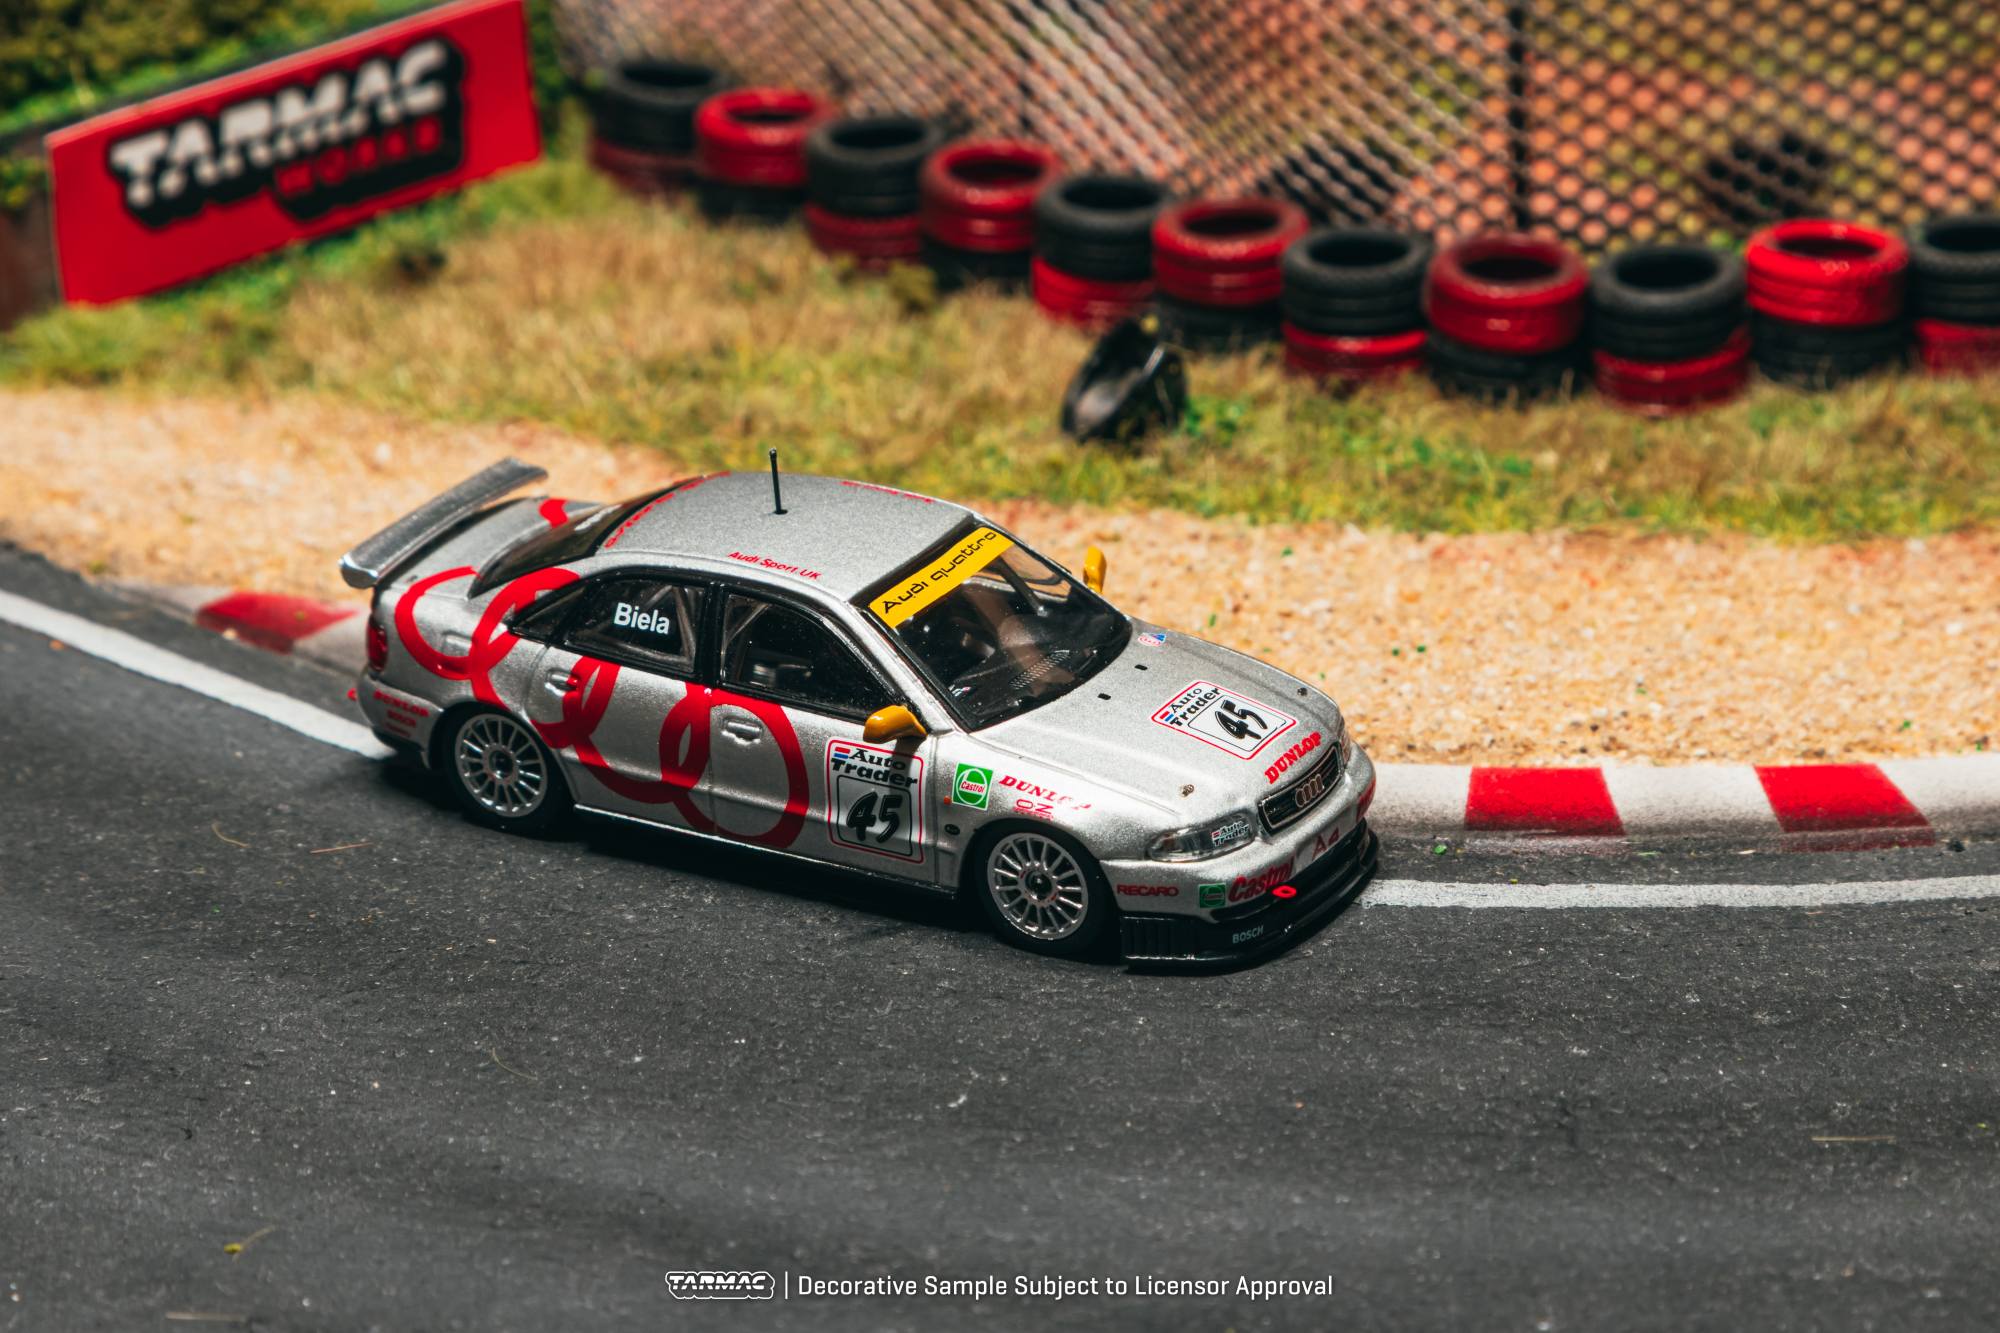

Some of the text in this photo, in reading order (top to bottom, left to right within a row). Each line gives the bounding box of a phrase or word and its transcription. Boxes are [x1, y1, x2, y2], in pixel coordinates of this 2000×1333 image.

[110, 39, 447, 207] TARMAC
[727, 551, 822, 580] Audi Sport UK
[882, 532, 997, 614] Audi quattro
[613, 602, 670, 635] Biela
[1169, 687, 1222, 727] Trader
[1170, 687, 1202, 713] Auto
[1214, 699, 1268, 740] 45
[848, 748, 907, 771] Auto
[1264, 731, 1322, 785] DUNLOP
[831, 758, 918, 788] Trader
[960, 780, 986, 793] Castrol
[846, 791, 903, 843] 45
[1221, 820, 1244, 834] Auto
[1214, 826, 1249, 846] Trader
[1116, 884, 1179, 897] RECARO
[1232, 925, 1264, 944] BOSCH
